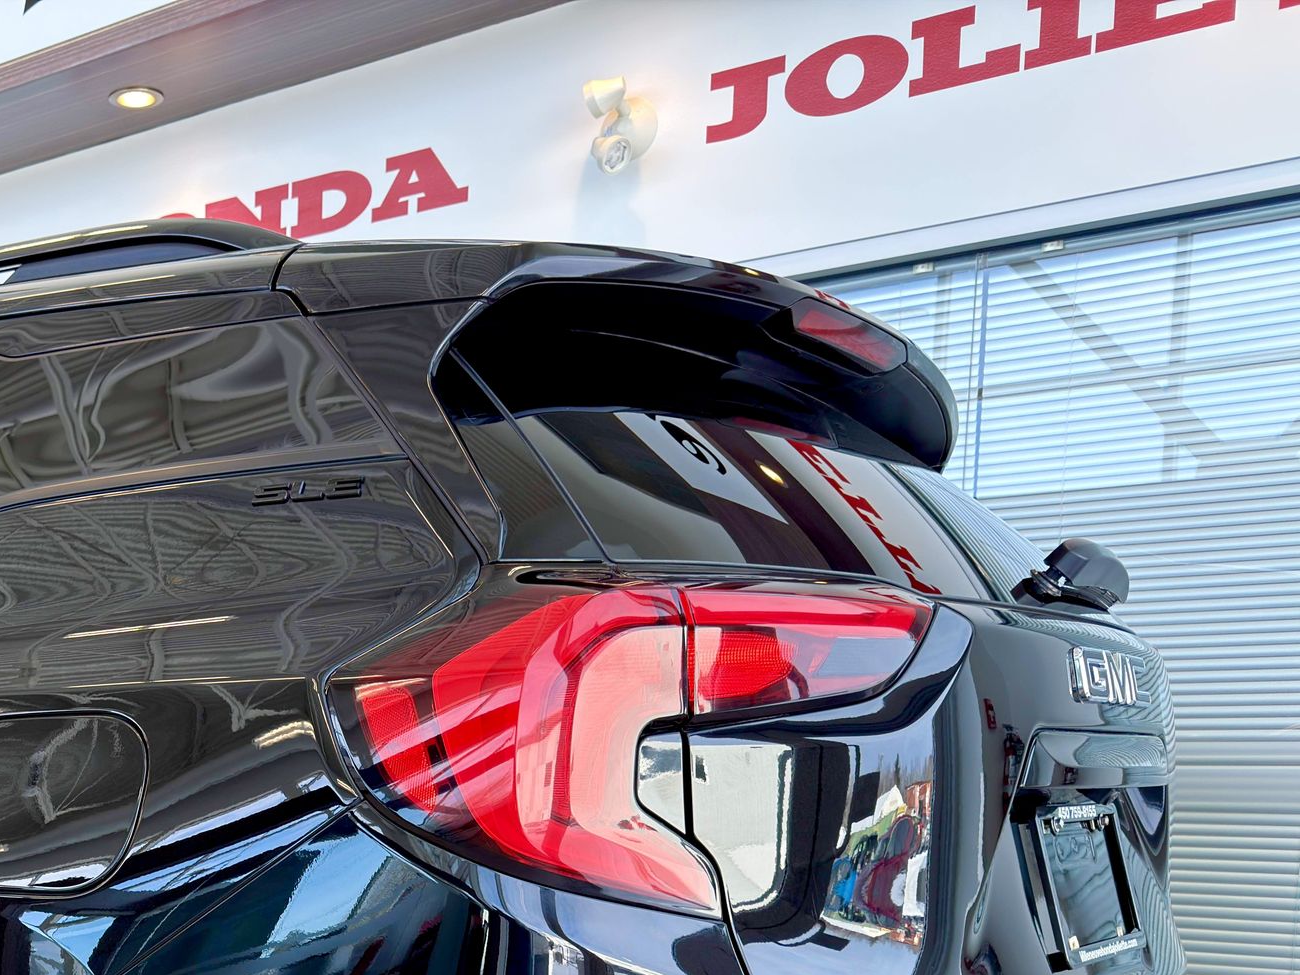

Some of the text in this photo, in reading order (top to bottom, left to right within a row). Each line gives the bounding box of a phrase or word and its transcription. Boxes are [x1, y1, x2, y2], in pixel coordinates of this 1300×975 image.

[158, 147, 470, 240] NDA
[251, 476, 366, 507] SLE
[1068, 646, 1152, 706] GMC
[1058, 806, 1070, 820] 450
